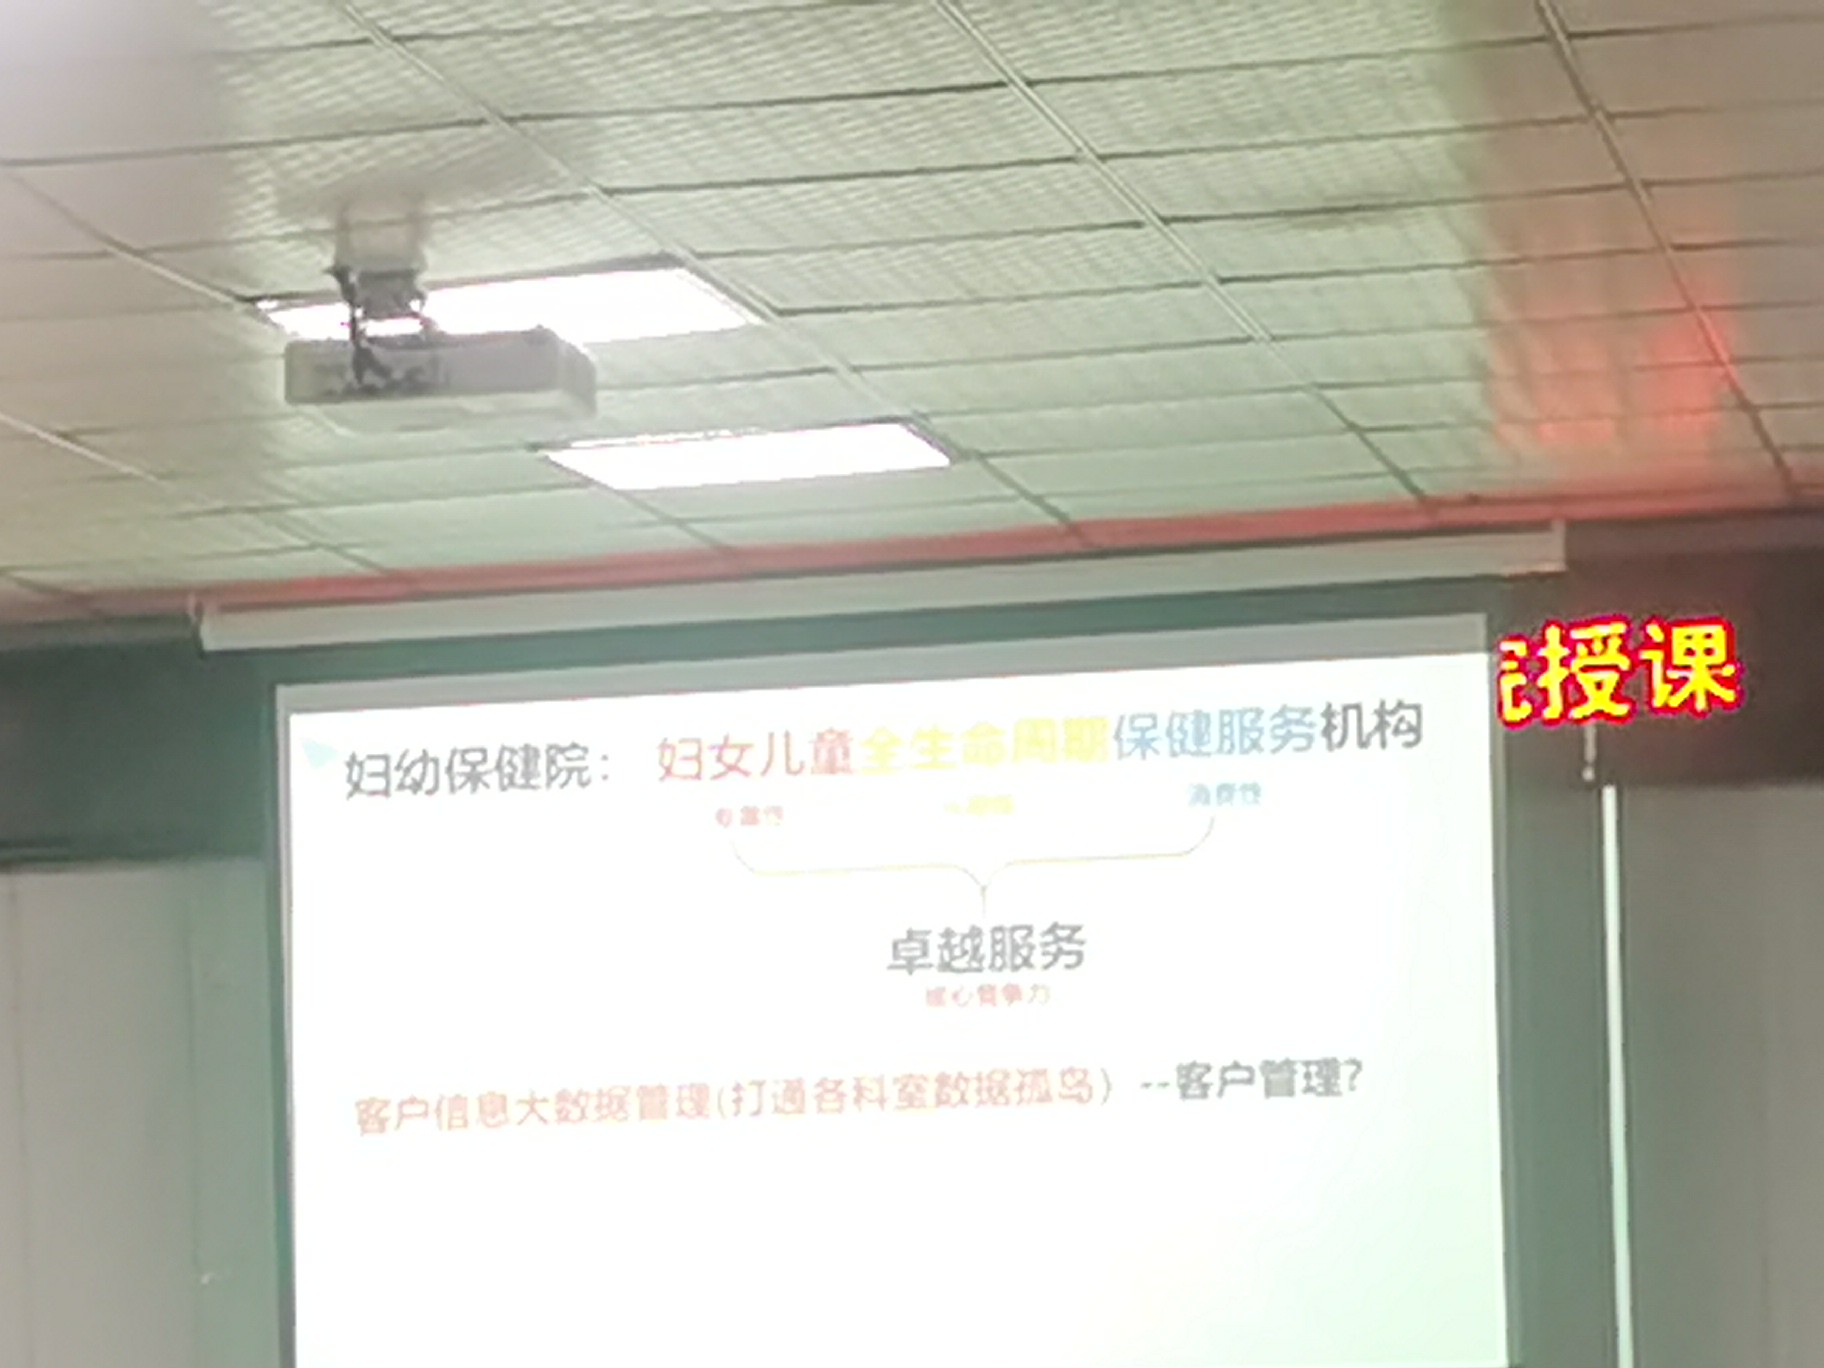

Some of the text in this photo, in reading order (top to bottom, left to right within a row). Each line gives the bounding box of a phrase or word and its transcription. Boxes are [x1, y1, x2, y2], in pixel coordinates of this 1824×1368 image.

[656, 700, 1423, 782] 妇女儿童全生命周期保健服务机构
[886, 921, 1086, 976] 卓越服务
